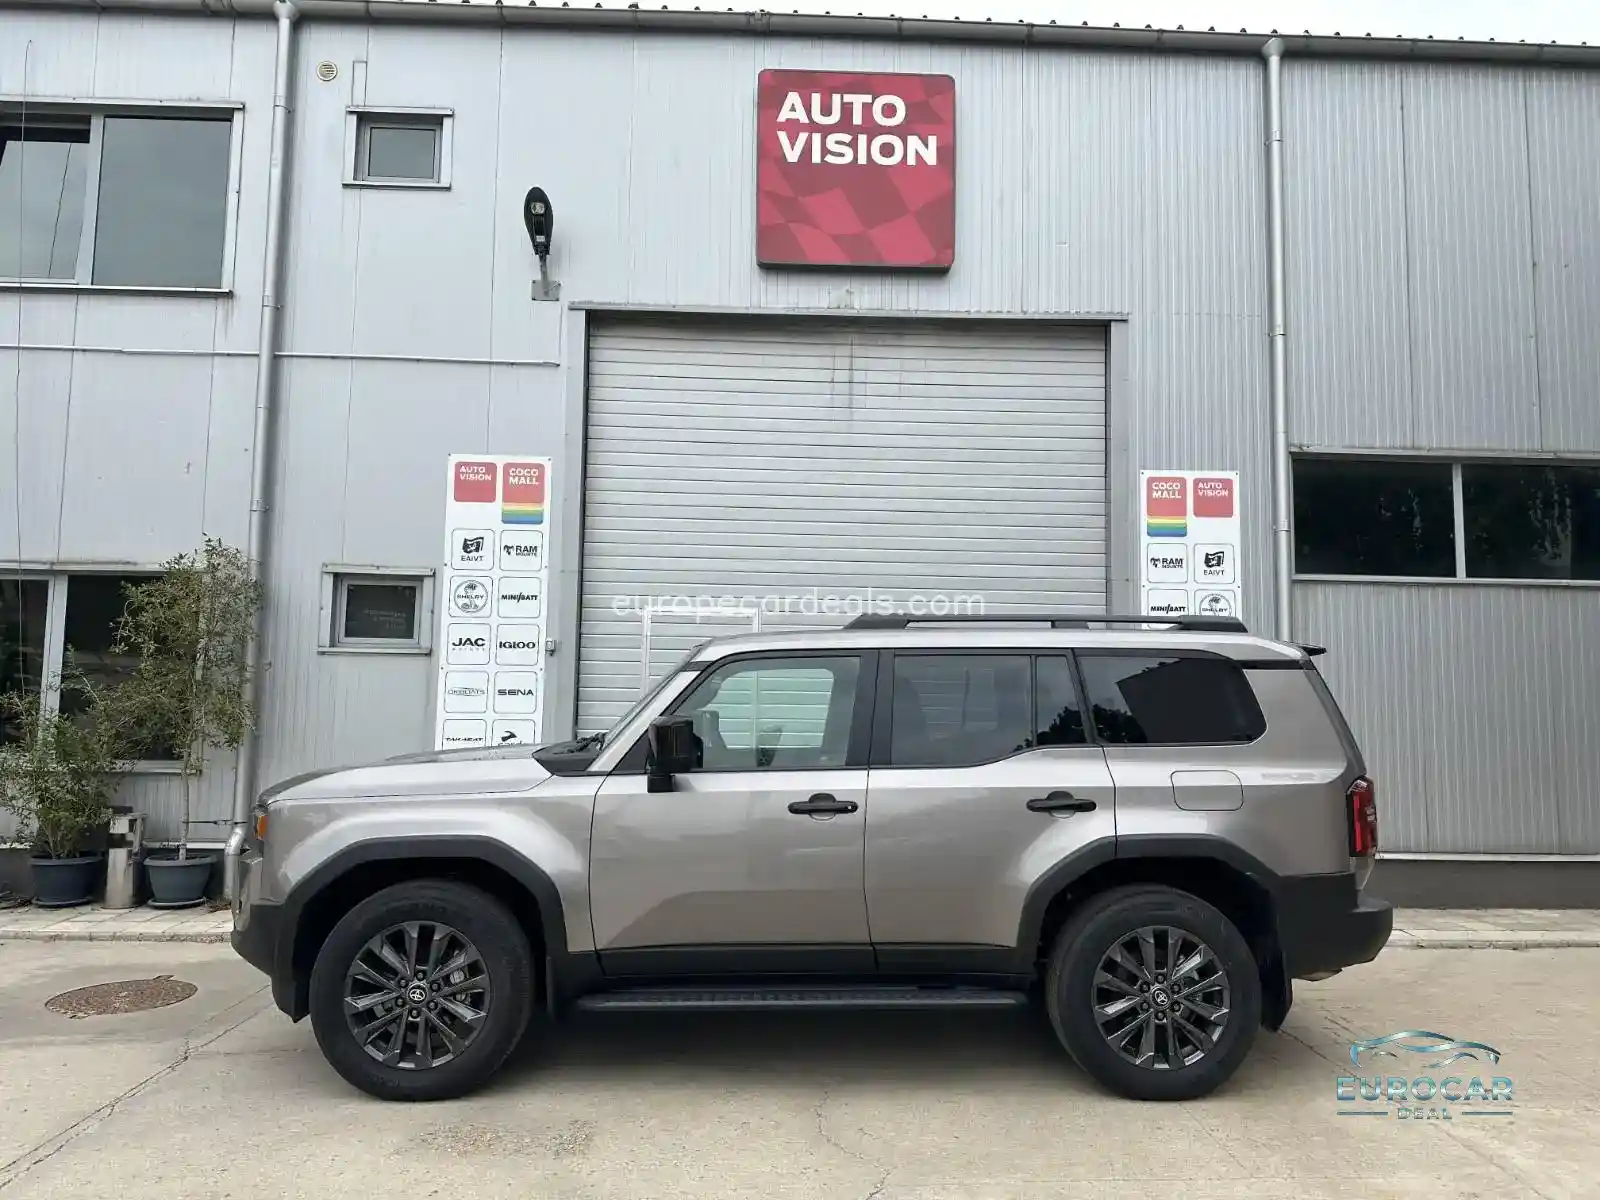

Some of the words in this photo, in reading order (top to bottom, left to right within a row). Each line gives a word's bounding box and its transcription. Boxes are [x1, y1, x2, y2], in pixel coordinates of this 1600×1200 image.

[776, 91, 906, 127] AUTO
[776, 130, 937, 166] VISION
[460, 465, 486, 473] AUTO
[509, 467, 539, 476] COCO
[460, 473, 492, 481] VISION
[509, 476, 539, 485] MALL
[1152, 481, 1181, 490] COCO
[1152, 490, 1181, 499] MALL
[1198, 489, 1229, 497] VISION
[1161, 557, 1183, 565] RAM
[452, 637, 486, 647] JAC
